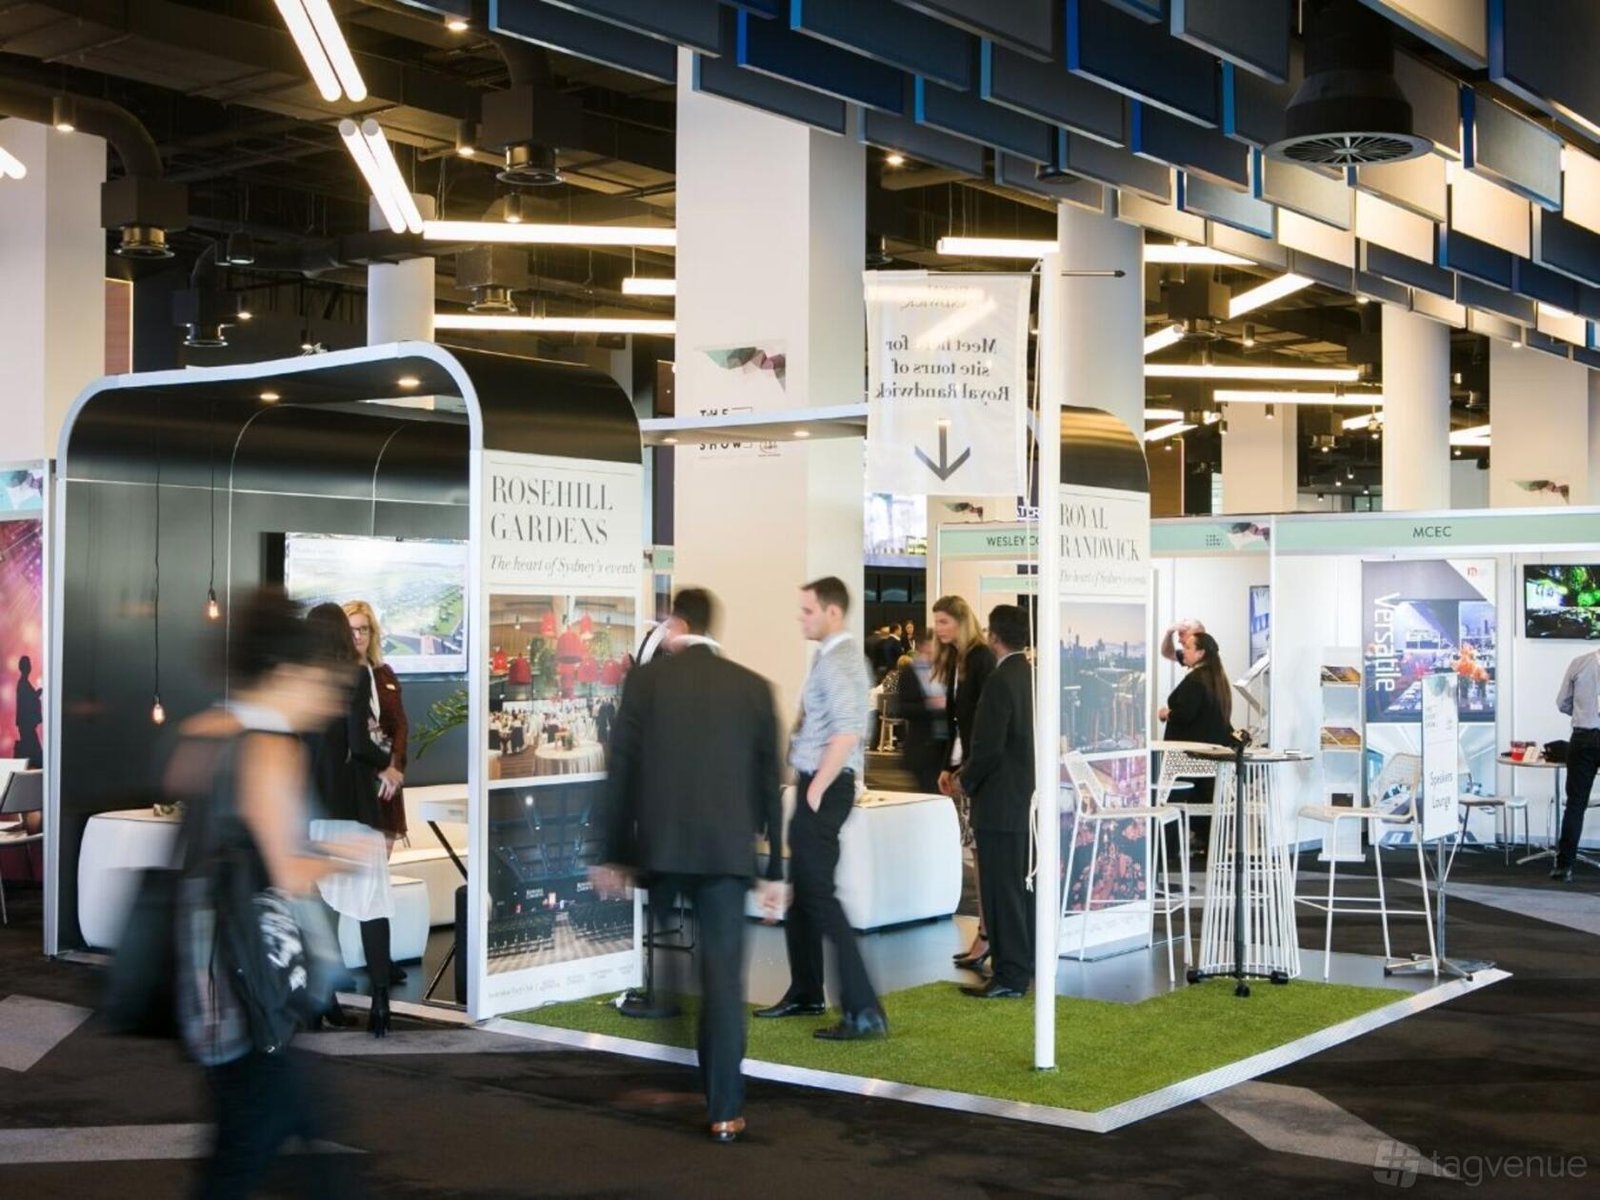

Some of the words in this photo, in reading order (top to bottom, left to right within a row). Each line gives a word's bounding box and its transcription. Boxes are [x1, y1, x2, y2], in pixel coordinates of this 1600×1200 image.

[492, 474, 614, 511] ROSEHILL
[490, 511, 608, 546] GARDENS
[1060, 502, 1109, 530] ROYAL
[986, 535, 1026, 547] WESLEY
[1412, 526, 1452, 539] MCEC
[1060, 533, 1141, 562] RANDWICK
[490, 553, 512, 571] The
[514, 556, 542, 572] heart
[544, 556, 557, 577] of
[1374, 592, 1401, 693] Versatile
